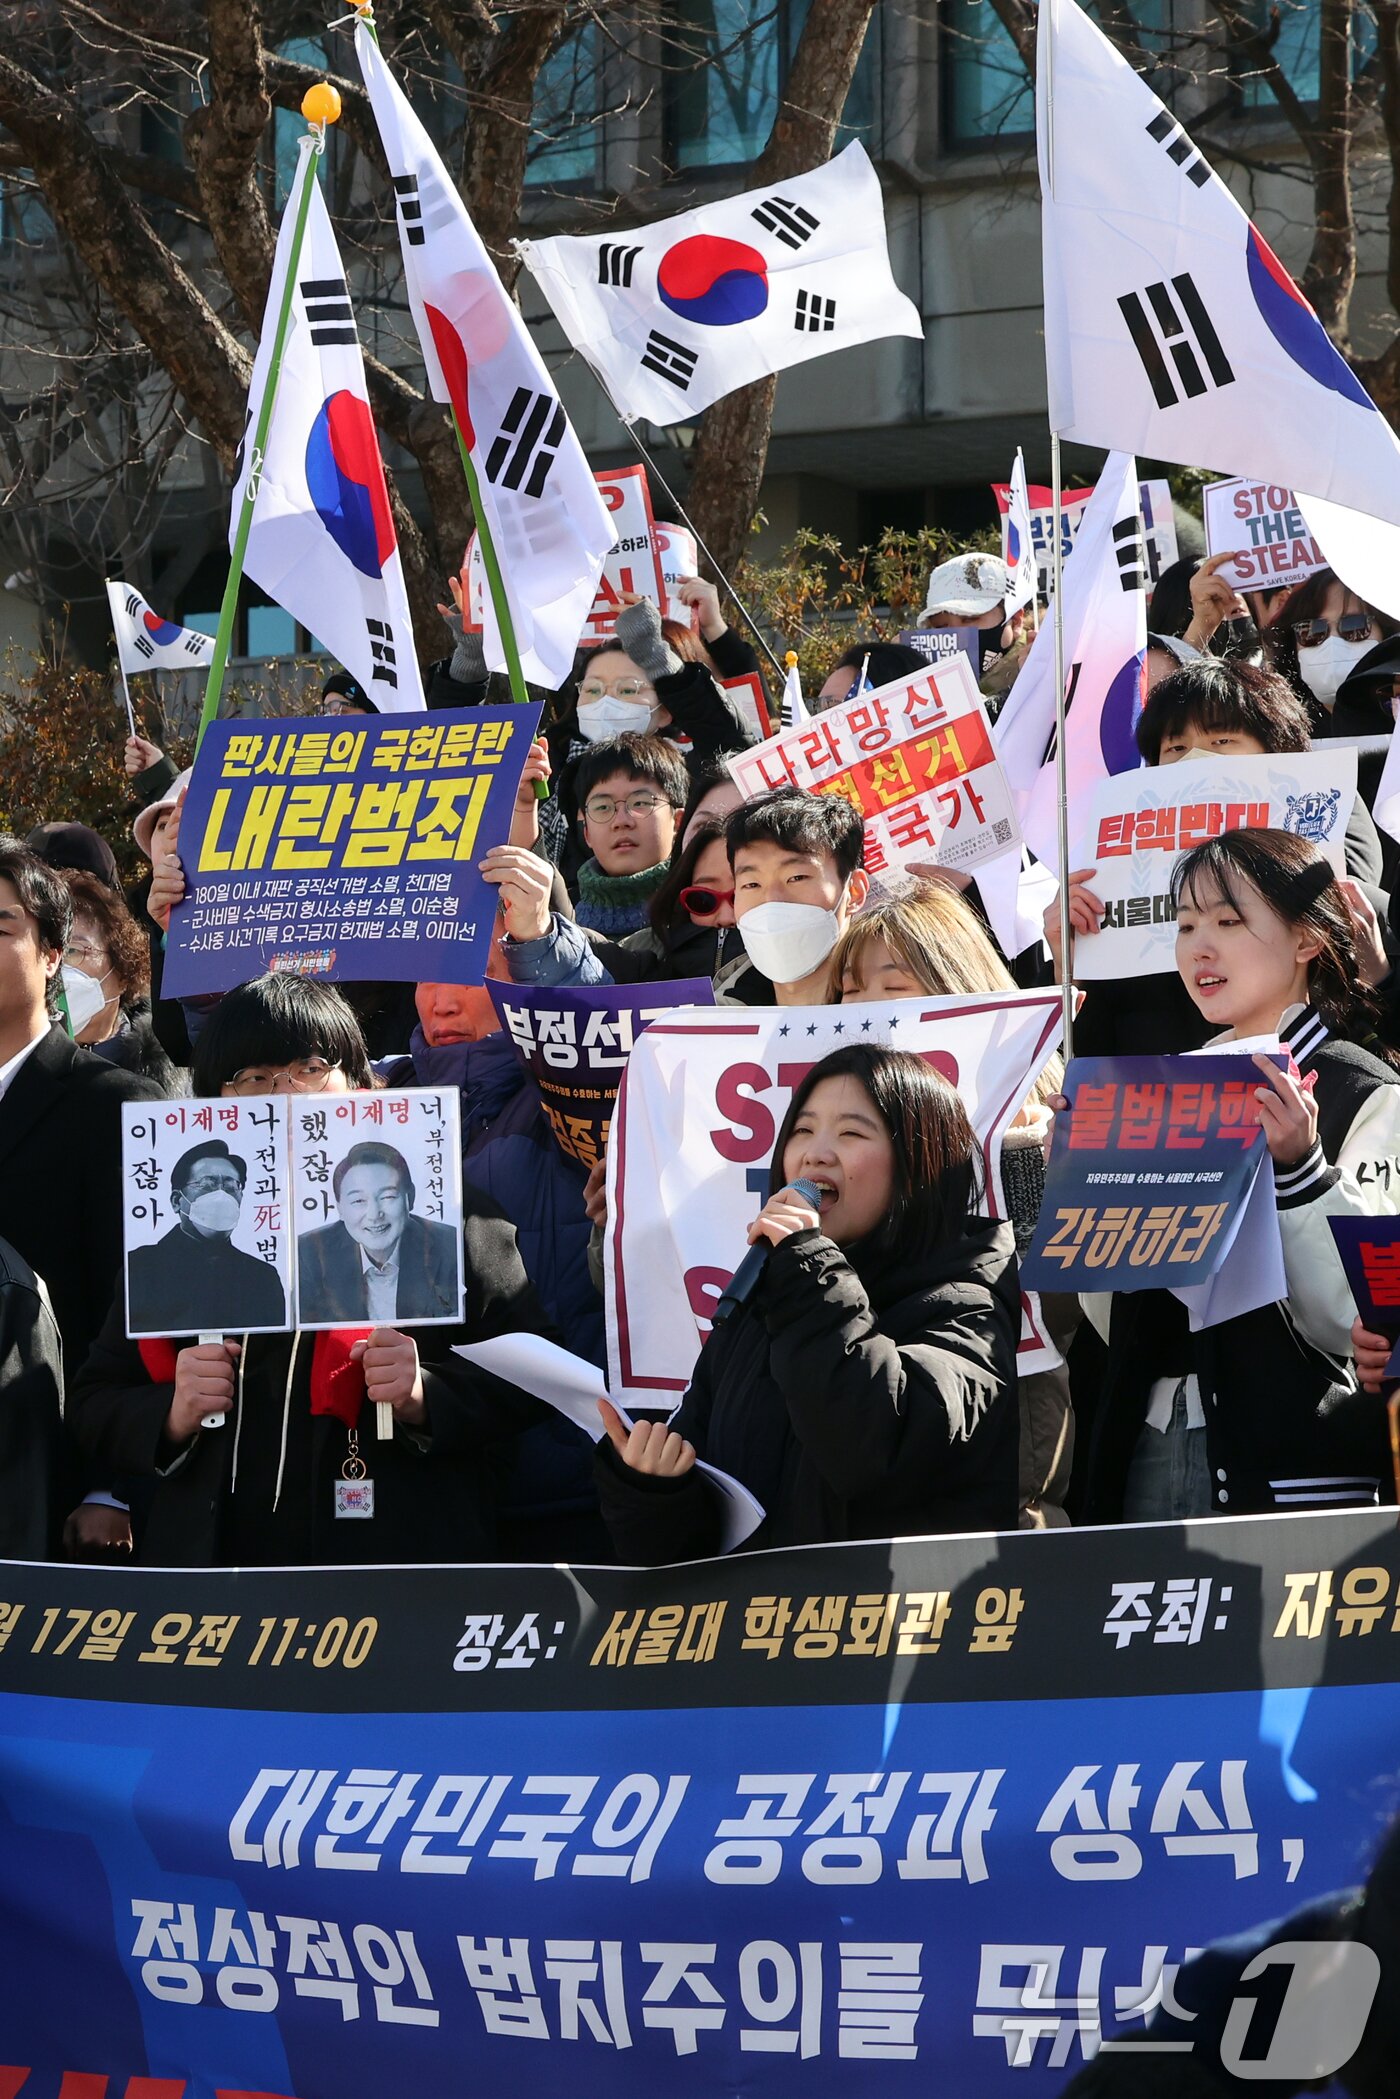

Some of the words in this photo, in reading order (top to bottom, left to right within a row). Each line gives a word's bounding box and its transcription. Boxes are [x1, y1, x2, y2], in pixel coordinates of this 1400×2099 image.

[1246, 509, 1306, 546] THE
[1266, 577, 1284, 586] SAVE
[1284, 573, 1307, 583] KOREA
[911, 633, 957, 652] 국민이여
[221, 731, 368, 778] 판사들의
[371, 721, 515, 772] 국헌문란
[197, 774, 494, 872] 내란범죄
[233, 881, 261, 900] 이내
[262, 879, 293, 898] 재판
[295, 877, 367, 897] 공직선거법
[368, 875, 400, 894] 소멸,
[405, 873, 452, 893] 천대엽
[192, 906, 240, 929] 군사비밀
[243, 902, 298, 923] 수색금지
[300, 898, 372, 919] 형사소송법
[373, 897, 406, 917] 소멸,
[411, 896, 459, 917] 이순형
[189, 931, 224, 953] 수사중
[226, 926, 278, 948] 사건기록
[281, 922, 337, 943] 요구금지
[339, 921, 384, 940] 헌재법
[386, 920, 420, 941] 소멸,
[426, 920, 476, 942] 이미선
[502, 1003, 694, 1069] 부정선
[335, 1098, 410, 1127] 이재명
[573, 1088, 601, 1099] 수호하는
[1067, 1081, 1263, 1150] 불법탄핵
[165, 1104, 240, 1134] 이재명
[1086, 1173, 1136, 1184] 자유민주주의를
[1136, 1173, 1165, 1184] 수호하는
[1165, 1173, 1195, 1184] 서울대인
[1195, 1171, 1224, 1183] 시국선언
[1041, 1201, 1230, 1270] 각하하라
[452, 1612, 565, 1672] 장소:
[589, 1600, 727, 1668] 서울대
[741, 1587, 955, 1661] 학생회관
[968, 1586, 1025, 1654] 앞
[1103, 1576, 1234, 1649] 주최:
[30, 1607, 138, 1662] 17일
[138, 1612, 242, 1668] 오전
[247, 1616, 379, 1670] 11:00
[228, 1767, 692, 1885] 대한민국의
[703, 1767, 1006, 1886] 공정과
[1035, 1760, 1304, 1884] 상식,
[131, 1898, 440, 2028] 정상적인
[456, 1934, 925, 2061] 법치주의를
